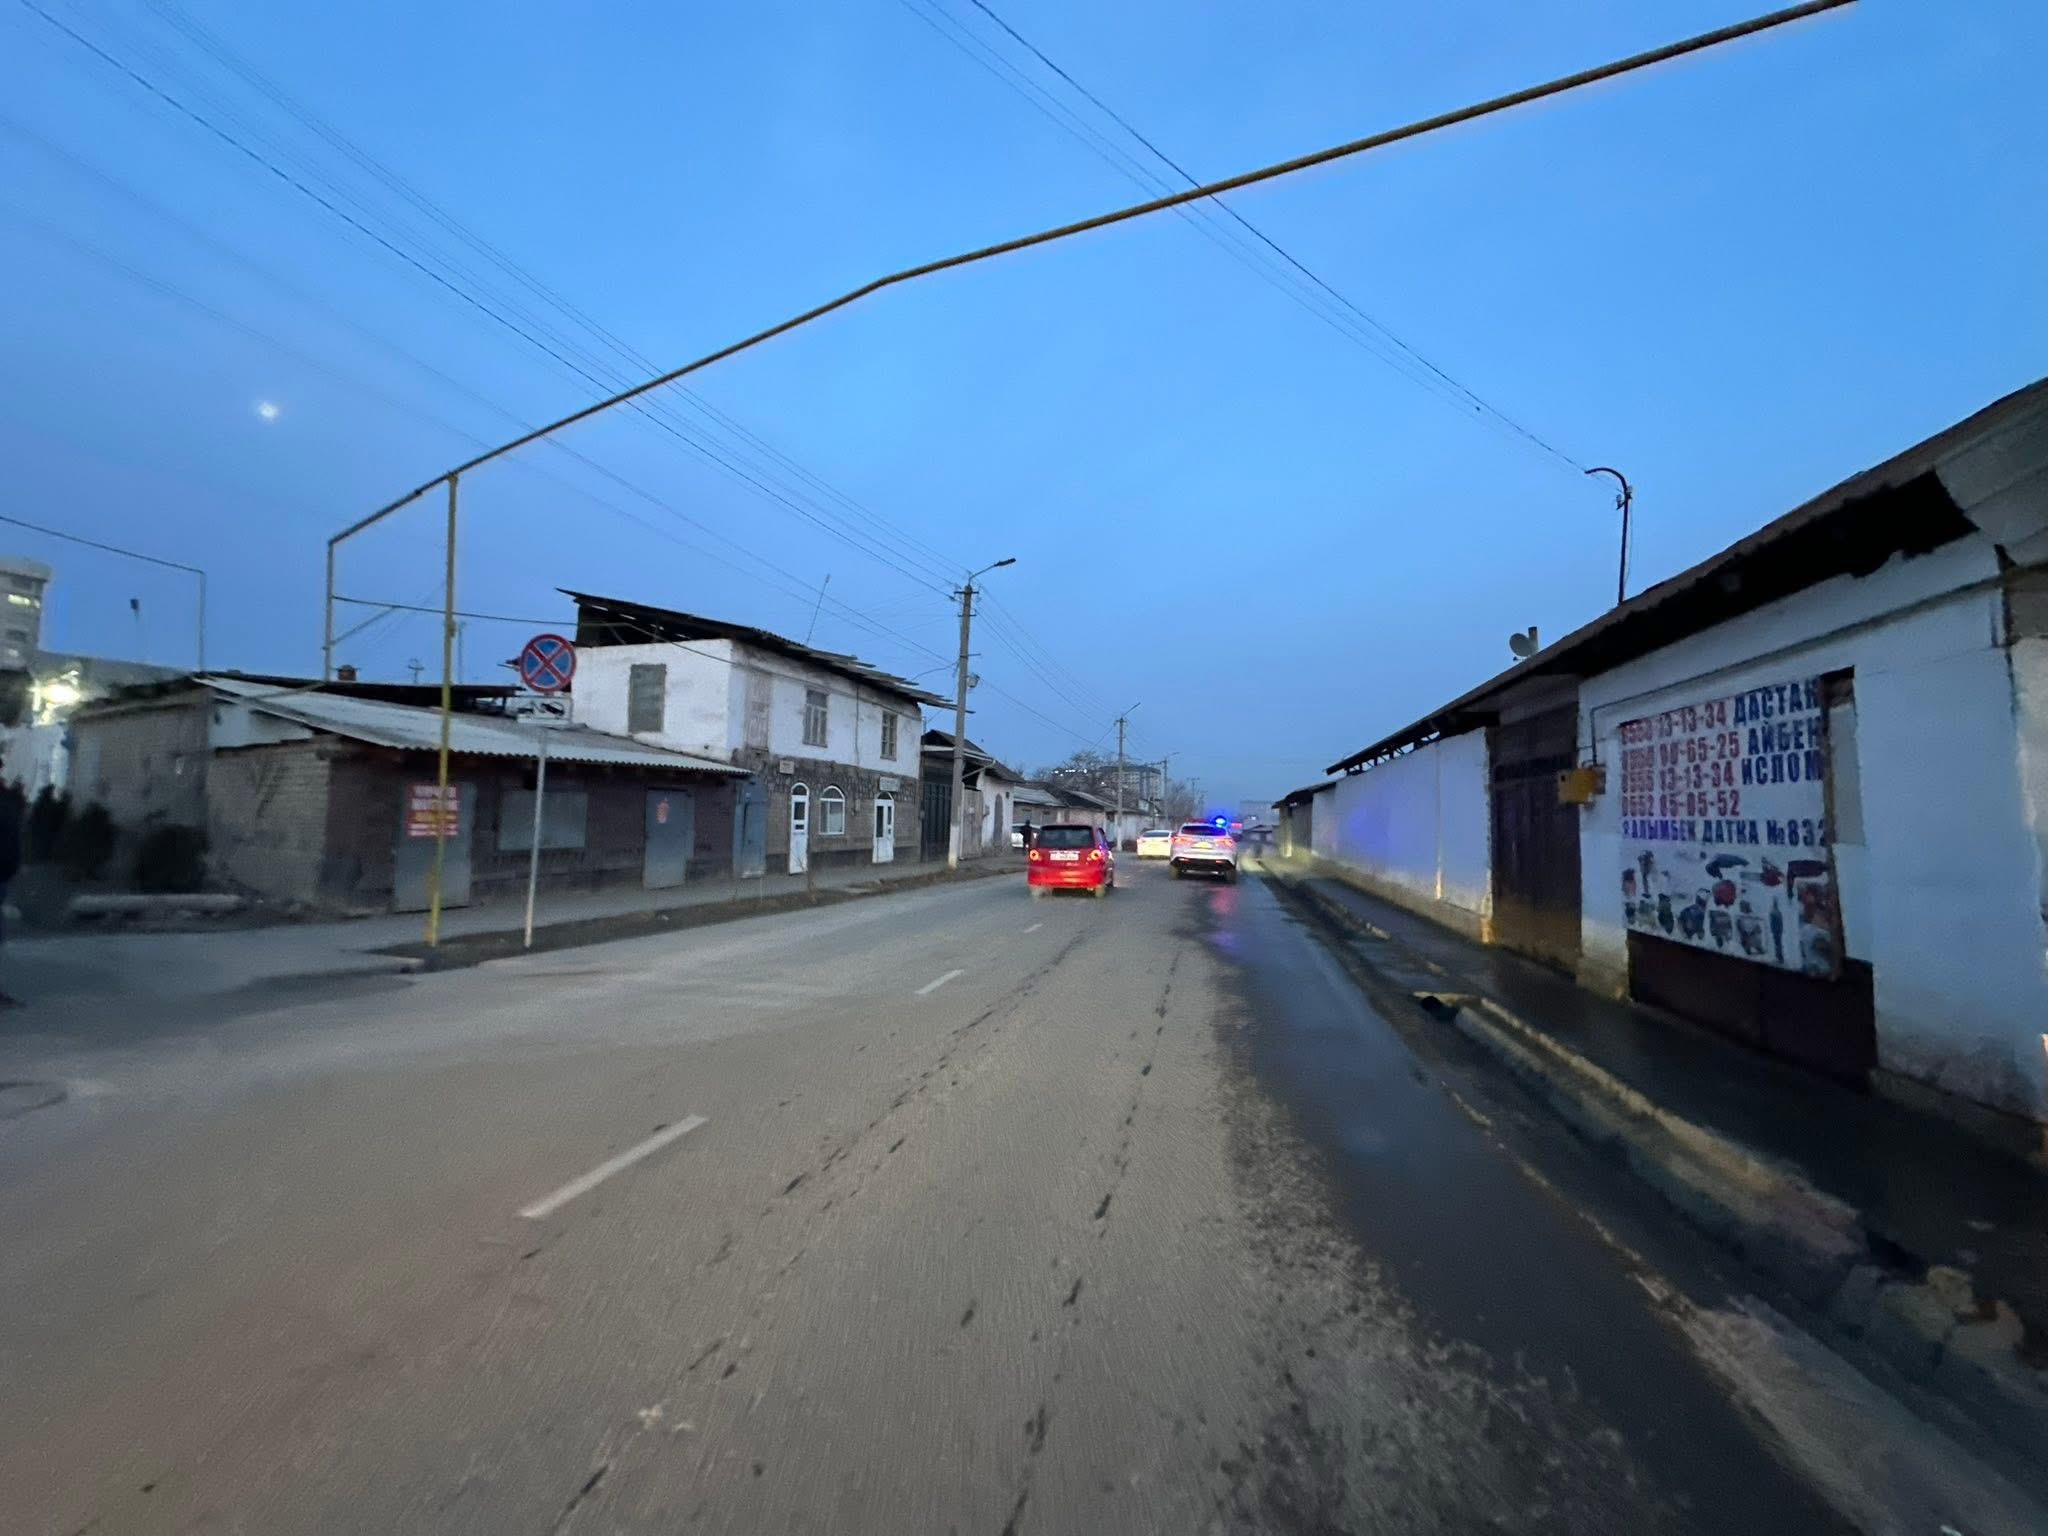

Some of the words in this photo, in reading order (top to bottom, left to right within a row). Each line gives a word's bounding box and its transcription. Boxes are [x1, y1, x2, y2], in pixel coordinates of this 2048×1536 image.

[1659, 702, 1726, 737] 13-13-34
[1659, 761, 1734, 791] 13-13-34
[1741, 750, 1825, 785] ИСЛОМ
[1702, 819, 1759, 845] ДАТКА
